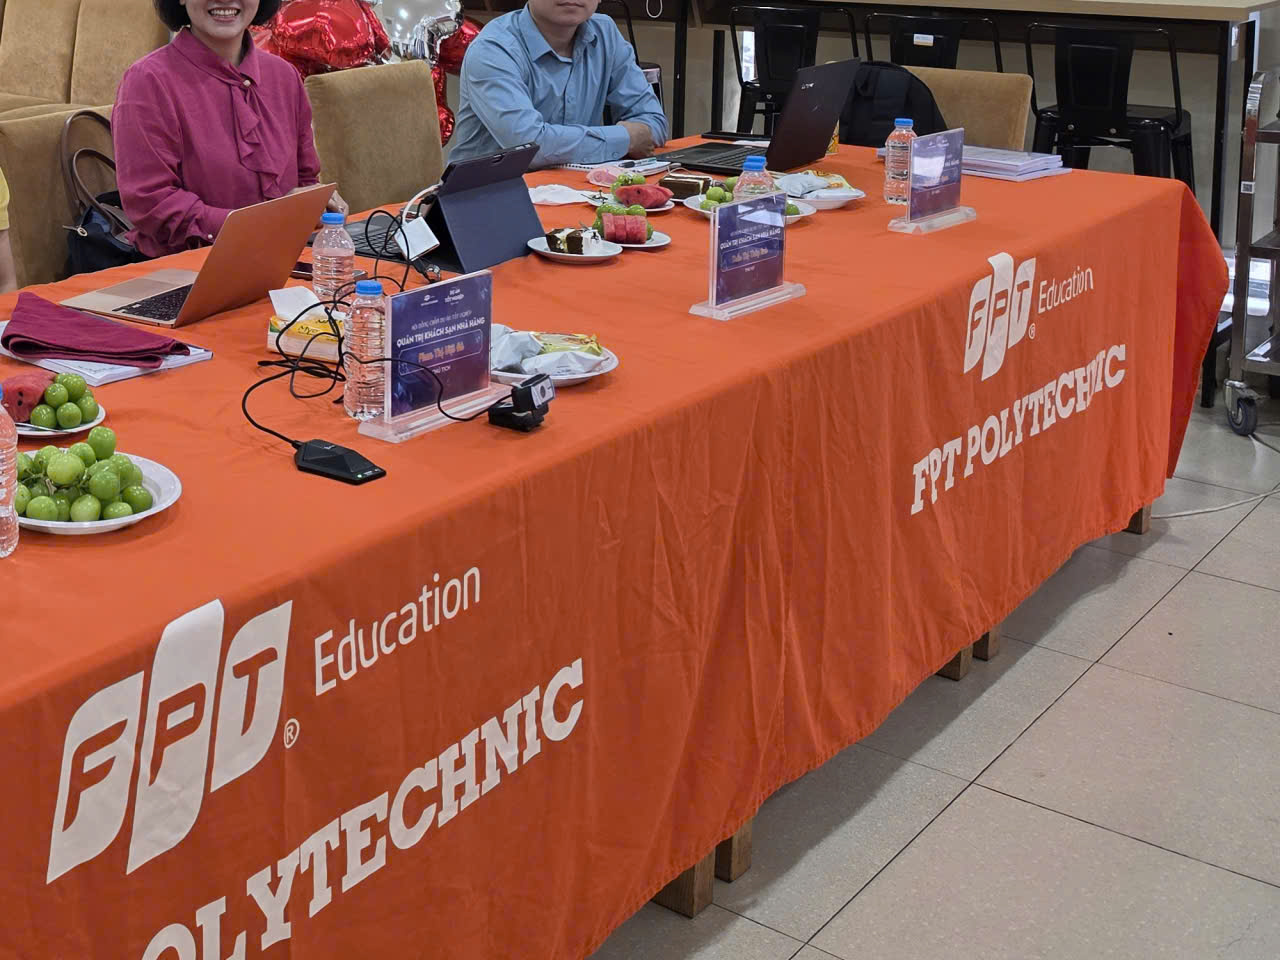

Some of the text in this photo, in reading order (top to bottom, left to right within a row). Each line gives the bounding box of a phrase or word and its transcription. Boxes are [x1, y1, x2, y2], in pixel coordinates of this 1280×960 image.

[424, 327, 445, 340] KHÁCH
[469, 317, 485, 328] HÀNG
[963, 252, 1036, 381] FPT
[1038, 266, 1093, 314] Education
[911, 436, 962, 515] FPT
[315, 566, 480, 696] Education
[46, 599, 292, 884] FPT
